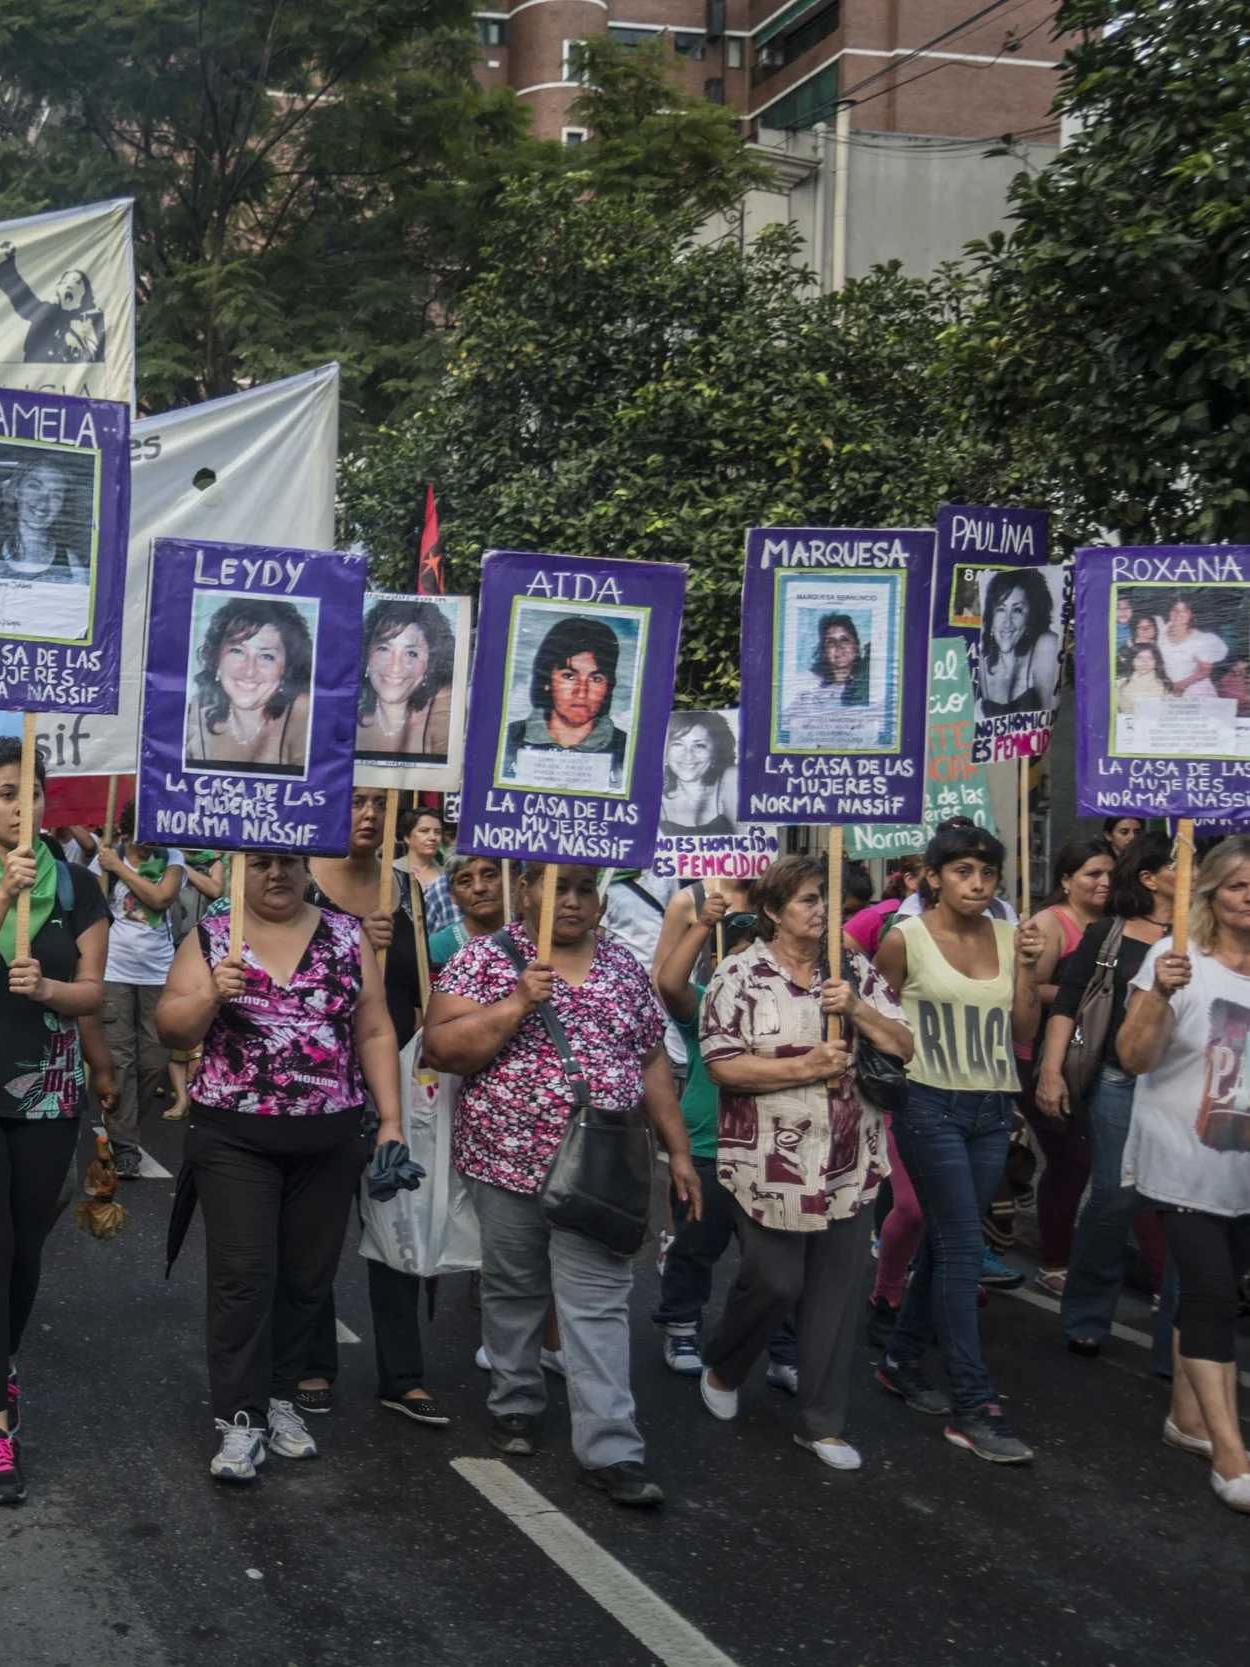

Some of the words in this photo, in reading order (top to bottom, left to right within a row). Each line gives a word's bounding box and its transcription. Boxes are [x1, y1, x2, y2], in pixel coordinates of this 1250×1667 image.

[760, 539, 909, 570] MARQUESA
[193, 551, 306, 594] LEYDY
[1112, 555, 1243, 583] ROXANA
[526, 571, 623, 605] AIDA
[37, 649, 59, 666] DE
[66, 649, 102, 671] LAS
[933, 650, 958, 681] el
[974, 720, 993, 739] NO
[994, 716, 1007, 736] ES
[972, 739, 991, 763] ES
[765, 757, 793, 775] LA
[802, 758, 853, 776] CASA
[857, 759, 882, 776] DE
[885, 759, 914, 778] LAS
[1098, 758, 1123, 776] LA
[1130, 759, 1179, 777] CASA
[1186, 762, 1211, 777] DE
[166, 773, 188, 792] LA
[194, 776, 246, 797] CASA
[254, 782, 279, 801] DE
[283, 783, 327, 807] LAS
[787, 777, 887, 796] MUJERES
[937, 787, 958, 805] de
[1129, 774, 1224, 796] MUJERES
[194, 795, 278, 821] MUJERES
[486, 791, 515, 813] LA
[523, 794, 569, 819] CASA
[574, 799, 598, 821] DE
[603, 802, 639, 825] LAS
[750, 795, 826, 815] NORMA
[1097, 791, 1168, 808] NORMA
[157, 809, 230, 838] NORMA
[521, 814, 608, 840] MUJERES
[473, 823, 547, 852] NORMA
[676, 837, 696, 853] ES
[854, 825, 926, 851] Norma
[653, 857, 676, 877] ES
[678, 853, 770, 878] FEMICIDIO
